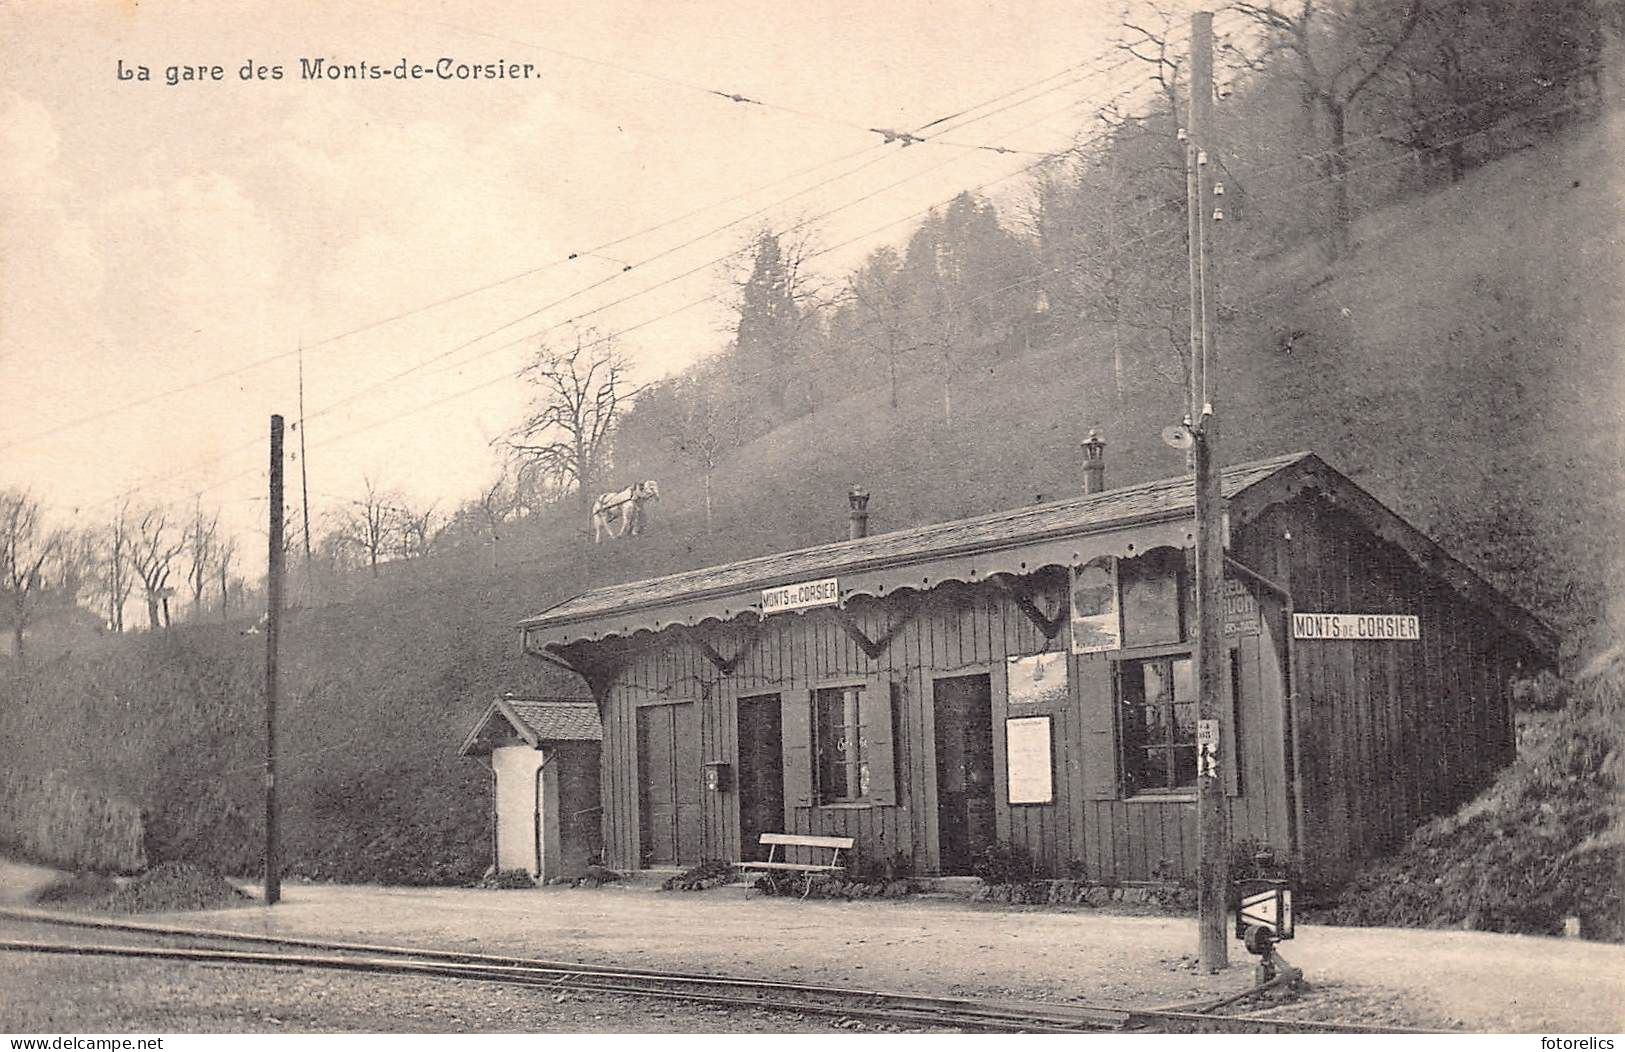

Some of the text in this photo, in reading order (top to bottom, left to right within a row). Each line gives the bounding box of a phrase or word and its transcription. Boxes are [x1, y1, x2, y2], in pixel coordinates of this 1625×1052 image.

[763, 589, 789, 608] MONTS
[799, 582, 837, 603] CORSIER
[1295, 616, 1417, 638] MONTS DE CORSIER
